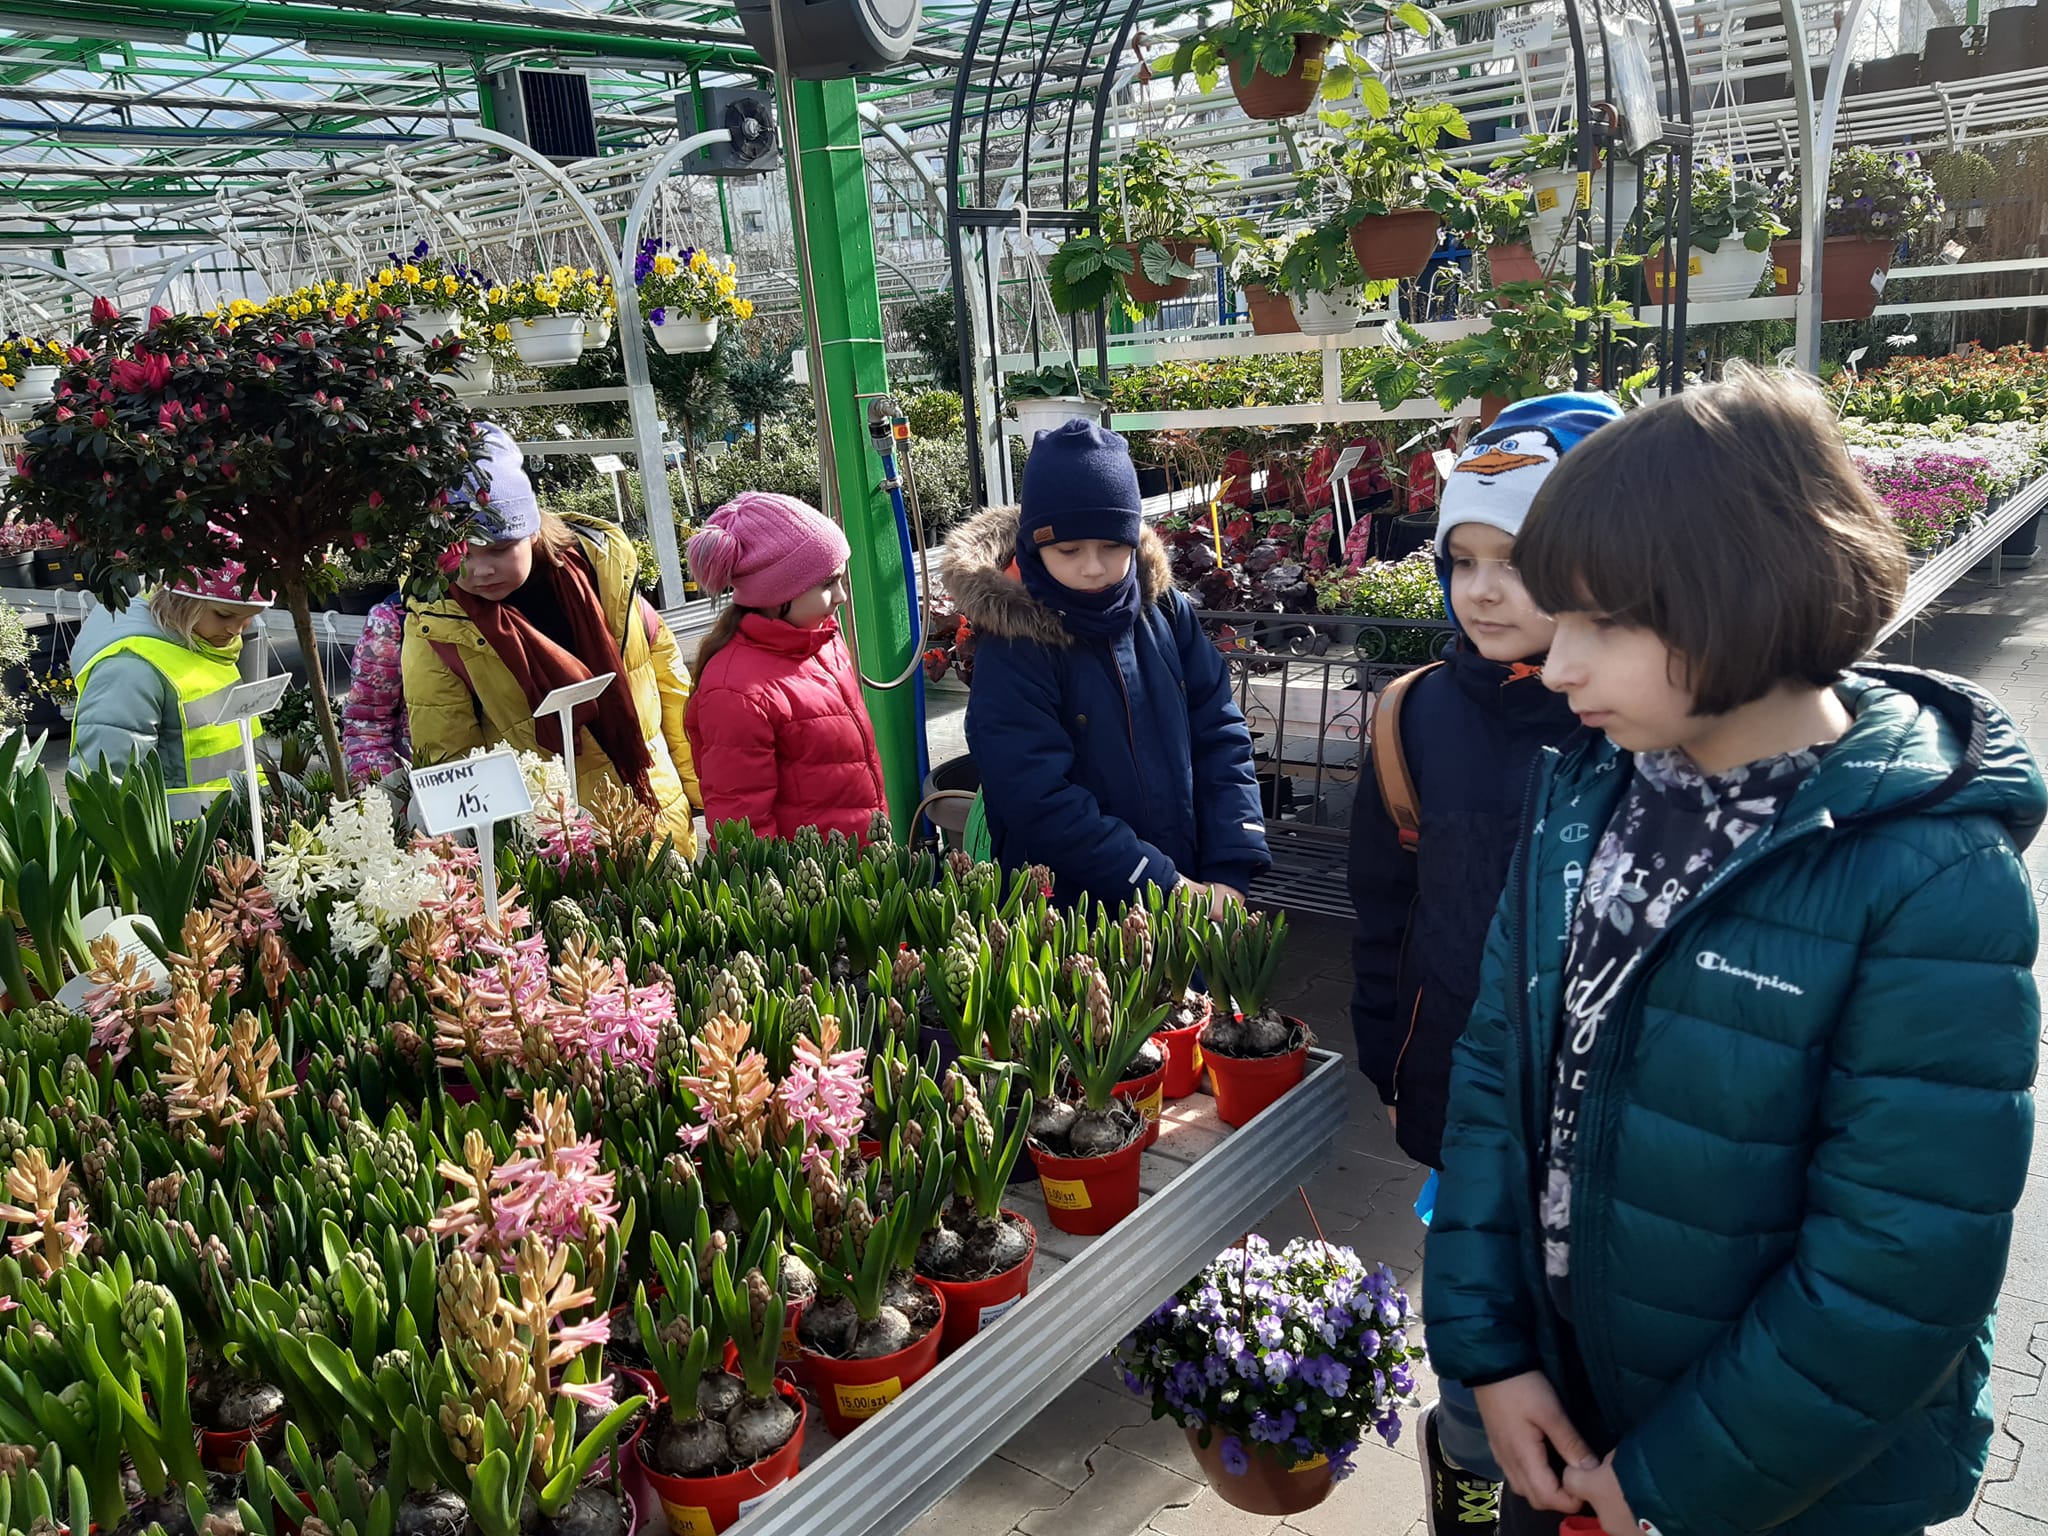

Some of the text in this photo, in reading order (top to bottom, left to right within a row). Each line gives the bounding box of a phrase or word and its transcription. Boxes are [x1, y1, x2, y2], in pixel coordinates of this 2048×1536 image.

[415, 763, 477, 790] HIACYNT
[1696, 951, 1804, 995] Champion
[840, 1395, 888, 1409] 15.00/szt
